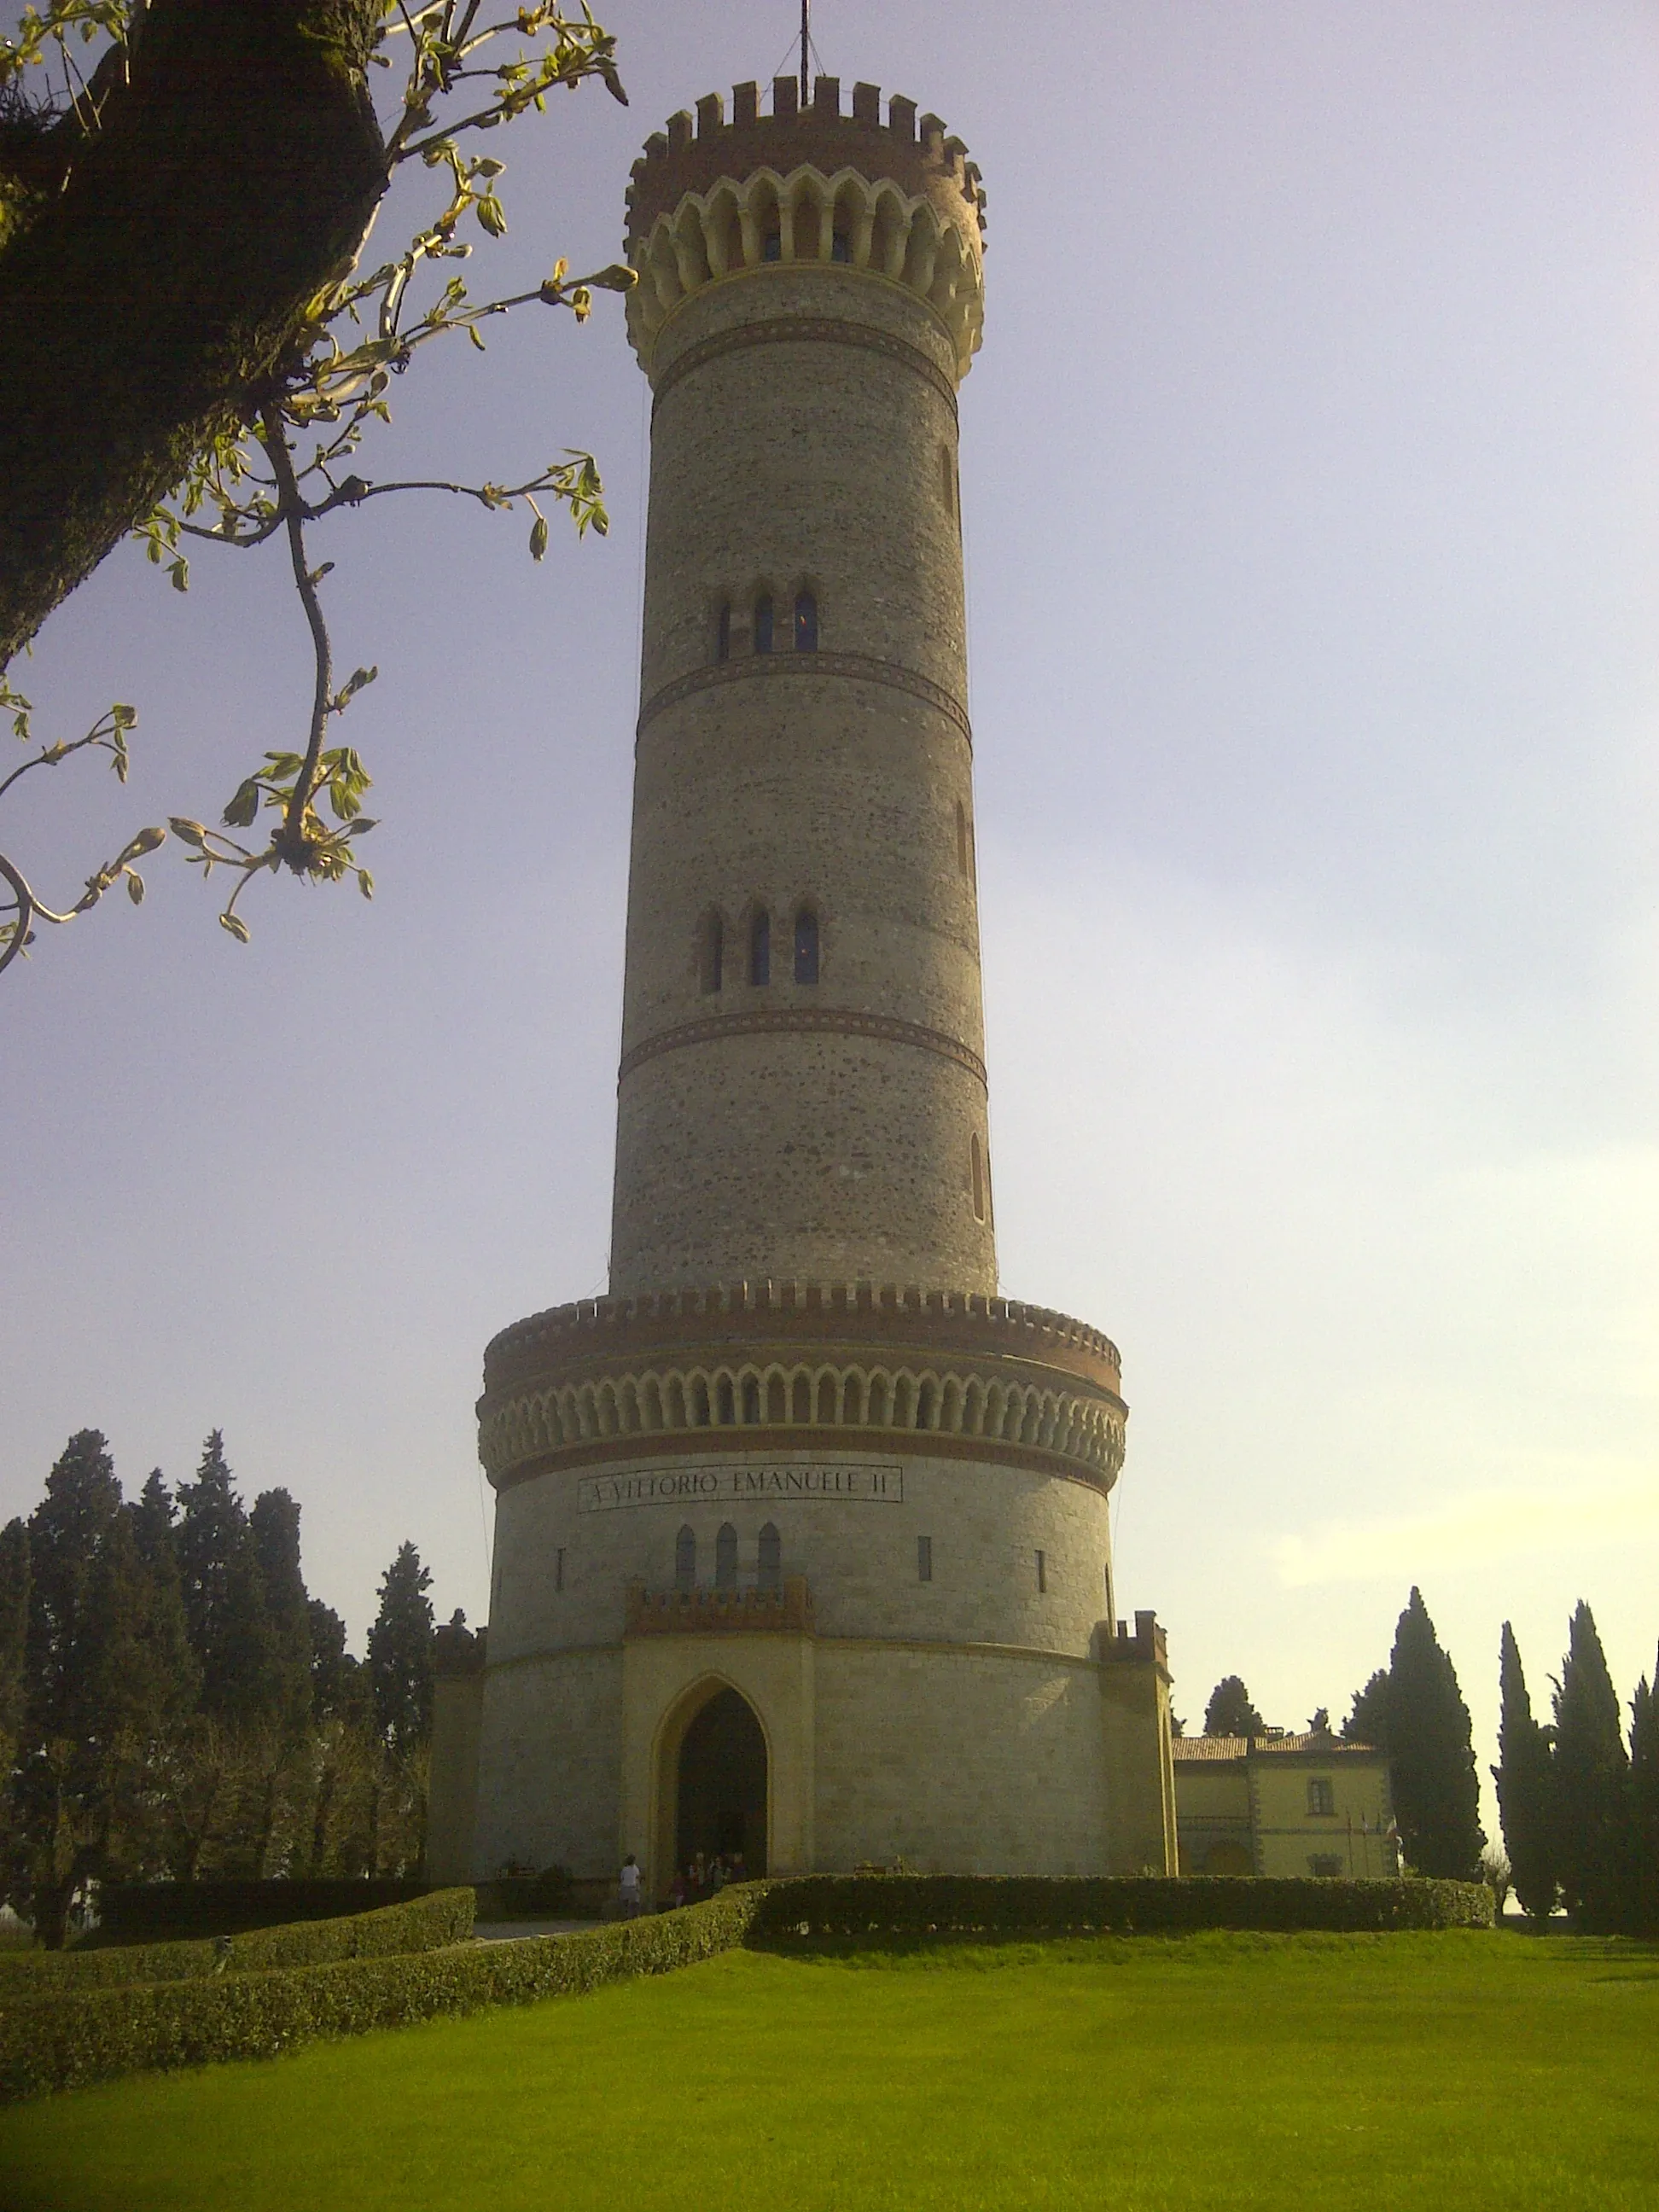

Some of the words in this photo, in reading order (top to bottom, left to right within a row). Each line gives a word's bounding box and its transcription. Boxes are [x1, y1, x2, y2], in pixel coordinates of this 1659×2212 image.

[591, 1484, 602, 1504] A
[613, 1474, 718, 1503] VITTORIO
[733, 1471, 858, 1493] EMANUELE
[872, 1474, 886, 1493] II
